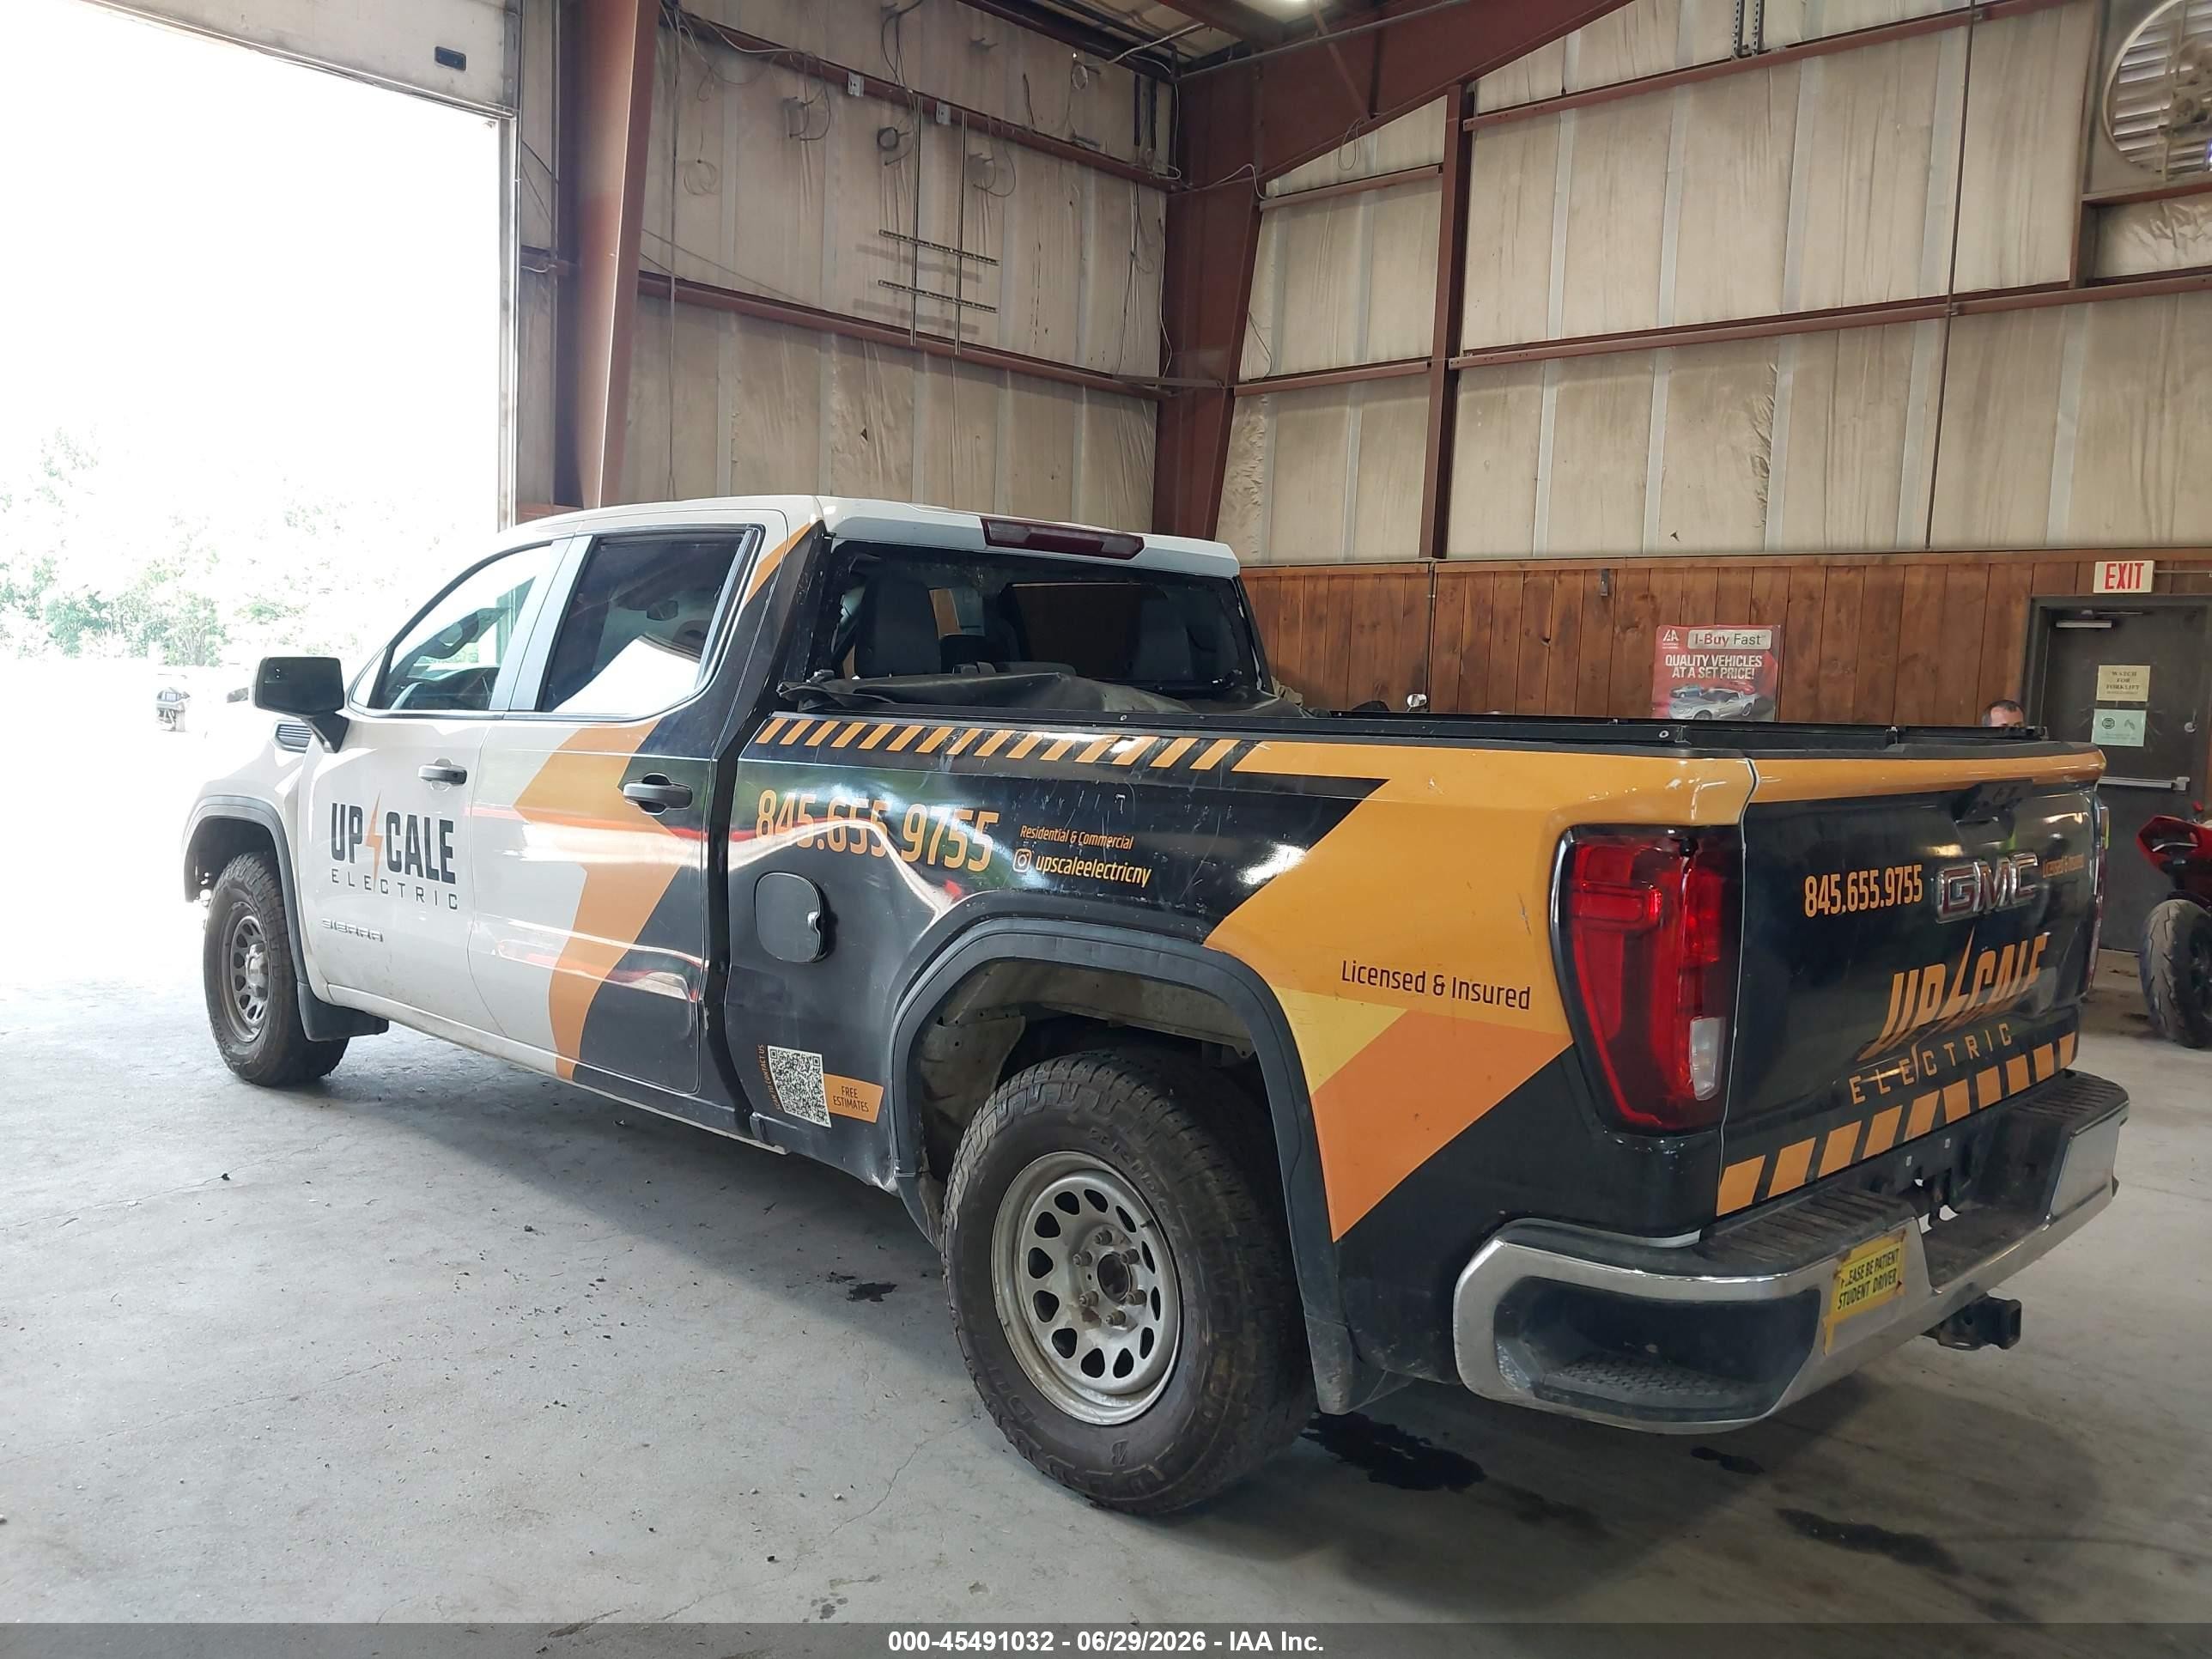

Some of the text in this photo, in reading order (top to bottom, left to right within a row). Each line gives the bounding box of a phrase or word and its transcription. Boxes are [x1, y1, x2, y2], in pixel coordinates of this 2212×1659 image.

[2104, 562, 2144, 591] EXIT
[1695, 633, 1729, 647] I-Buy
[1666, 655, 1763, 667] QUALITY VEHICLES
[1672, 667, 1755, 680] AT A SET PRICE!
[756, 789, 1000, 873] 845.6559755
[1020, 825, 1134, 850] Residential & Commercial
[1036, 855, 1152, 888] upscaleelectricny
[331, 868, 458, 910] ELECTRIC
[1804, 864, 1924, 918] 845.655.9755
[1935, 851, 2039, 924] GMC
[1341, 960, 1531, 1011] Licensed & Insured
[757, 1044, 765, 1054] US
[1849, 1023, 2012, 1105] ELECTRIC
[833, 1095, 869, 1112] ESTIMATES
[841, 1085, 859, 1099] FREE
[1865, 1260, 1874, 1277] BE
[1875, 1248, 1899, 1273] PATIENT
[1838, 1267, 1897, 1310] STUDENT DRIVER
